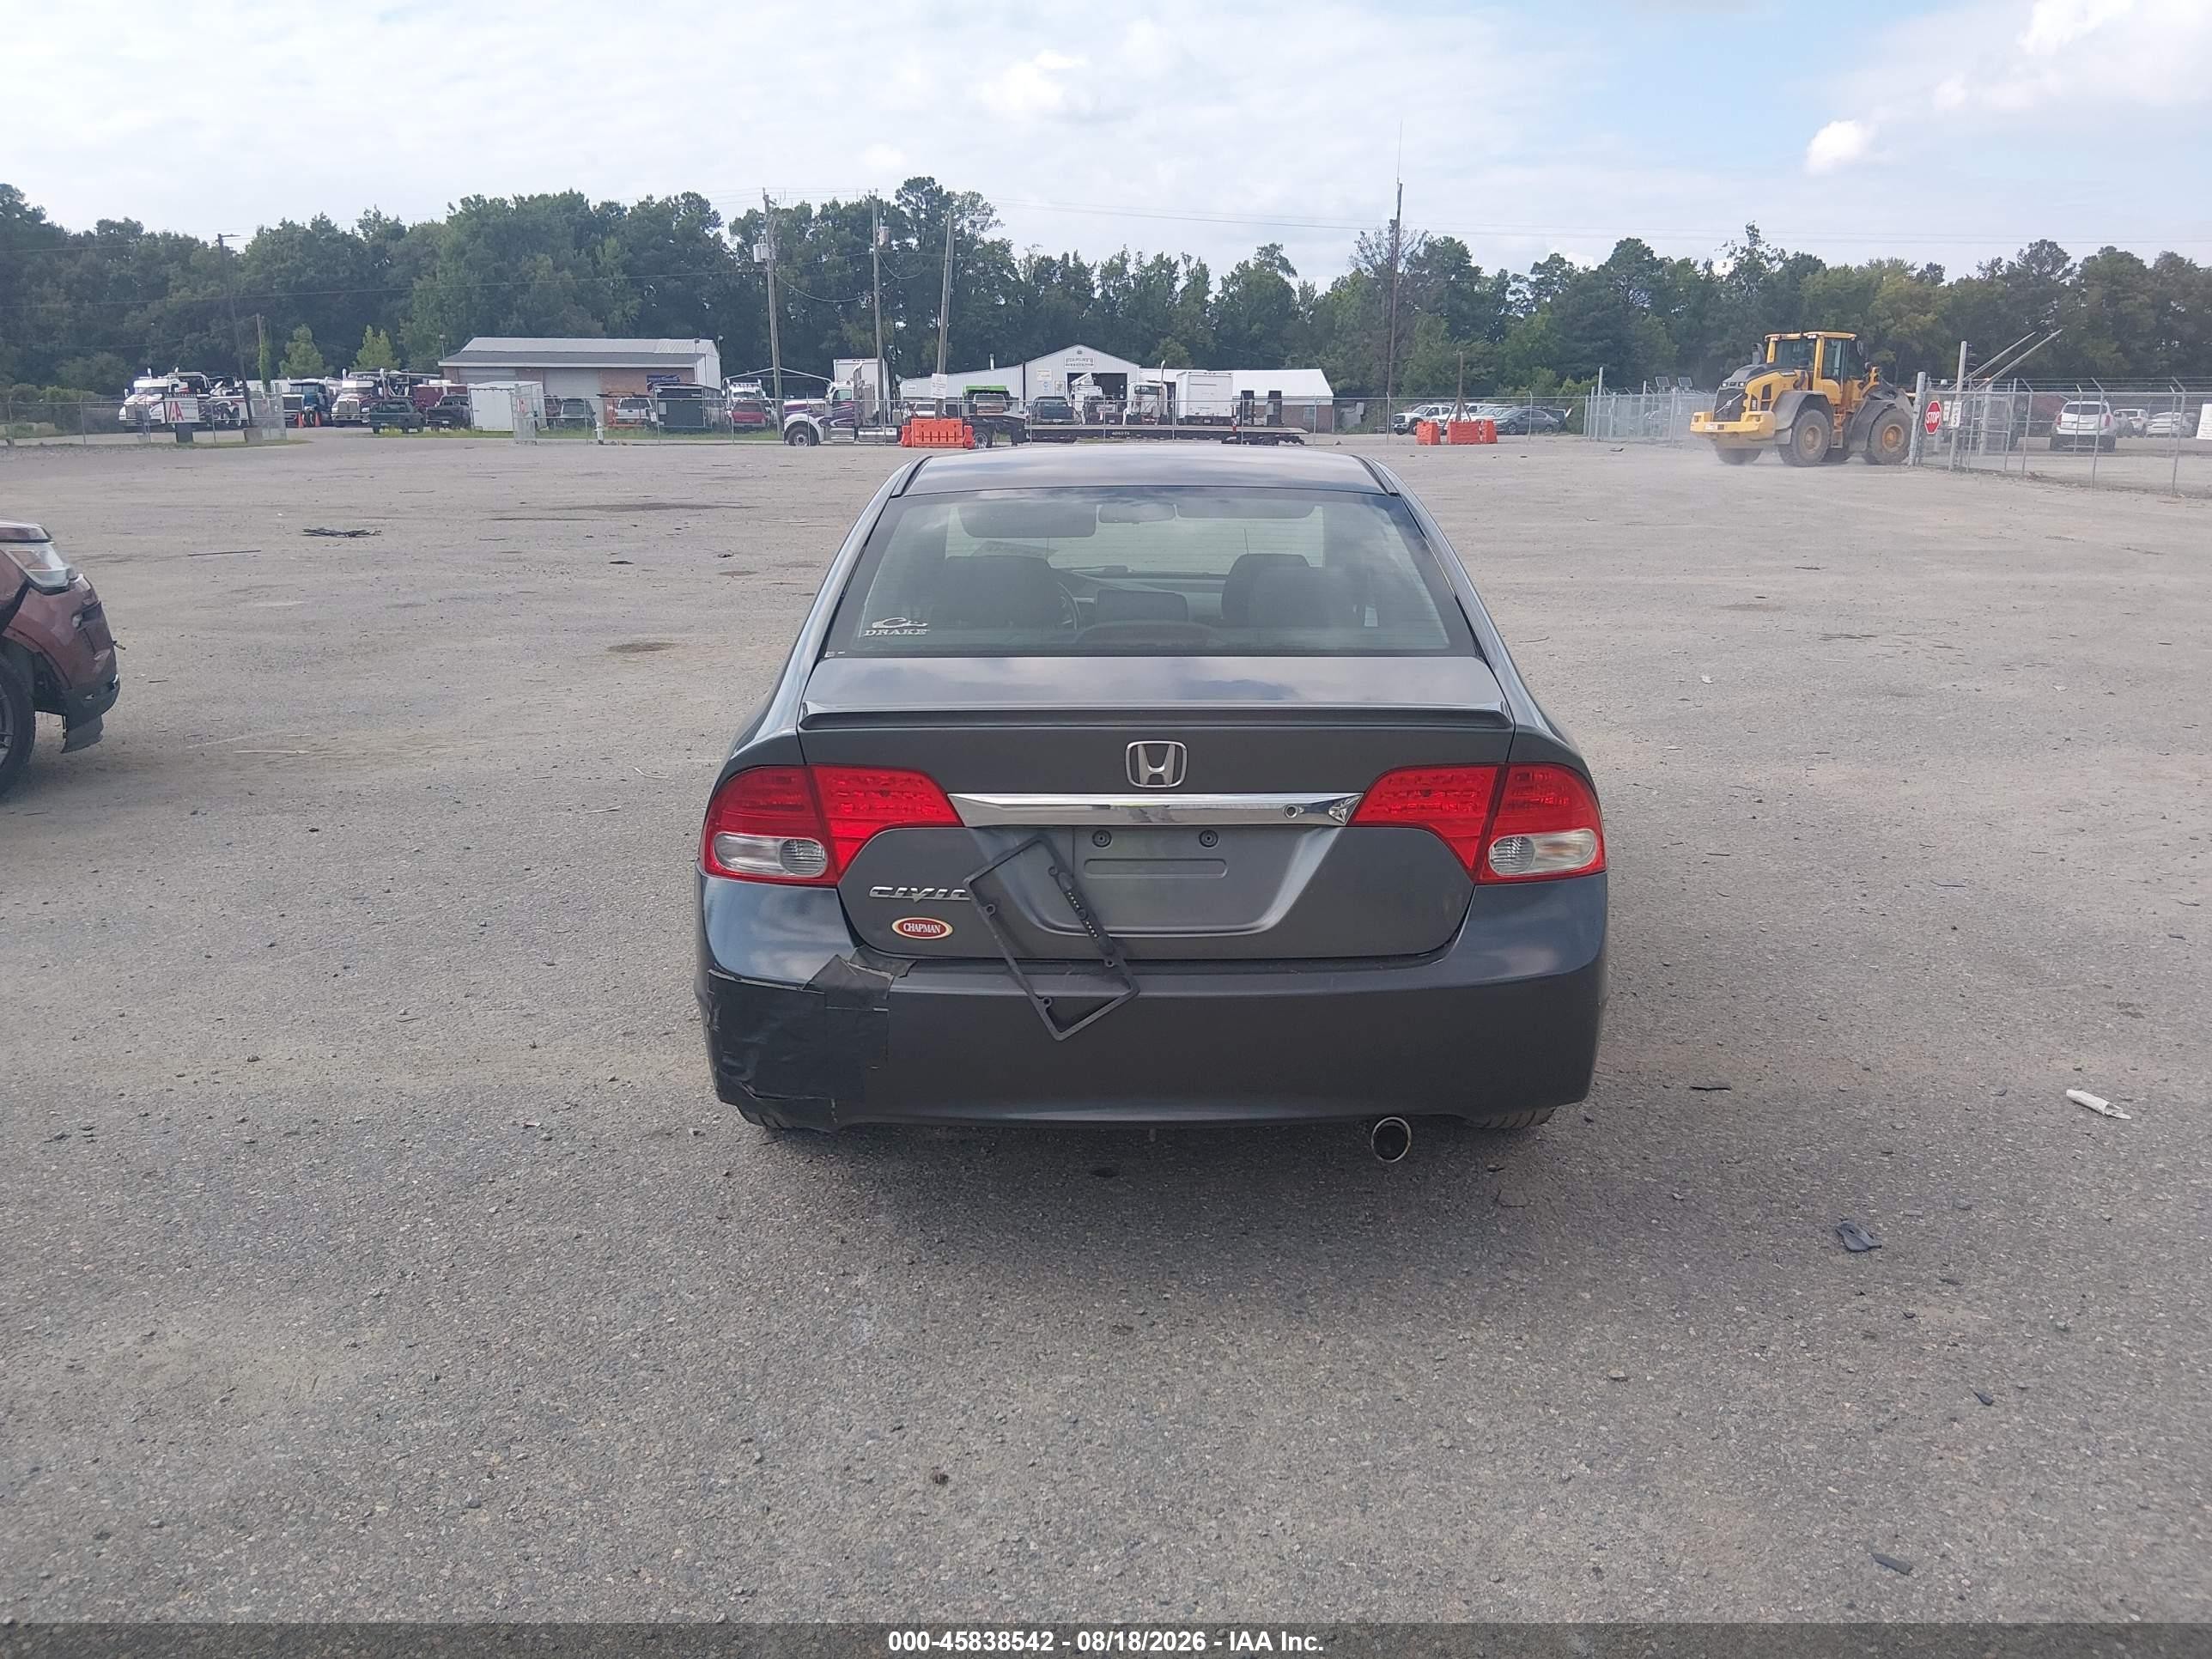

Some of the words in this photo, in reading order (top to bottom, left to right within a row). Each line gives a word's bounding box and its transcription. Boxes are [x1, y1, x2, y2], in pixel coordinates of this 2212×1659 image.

[1926, 411, 1940, 424] STOP
[869, 885, 971, 903] CIVIC
[902, 922, 942, 934] CHAPMAN
